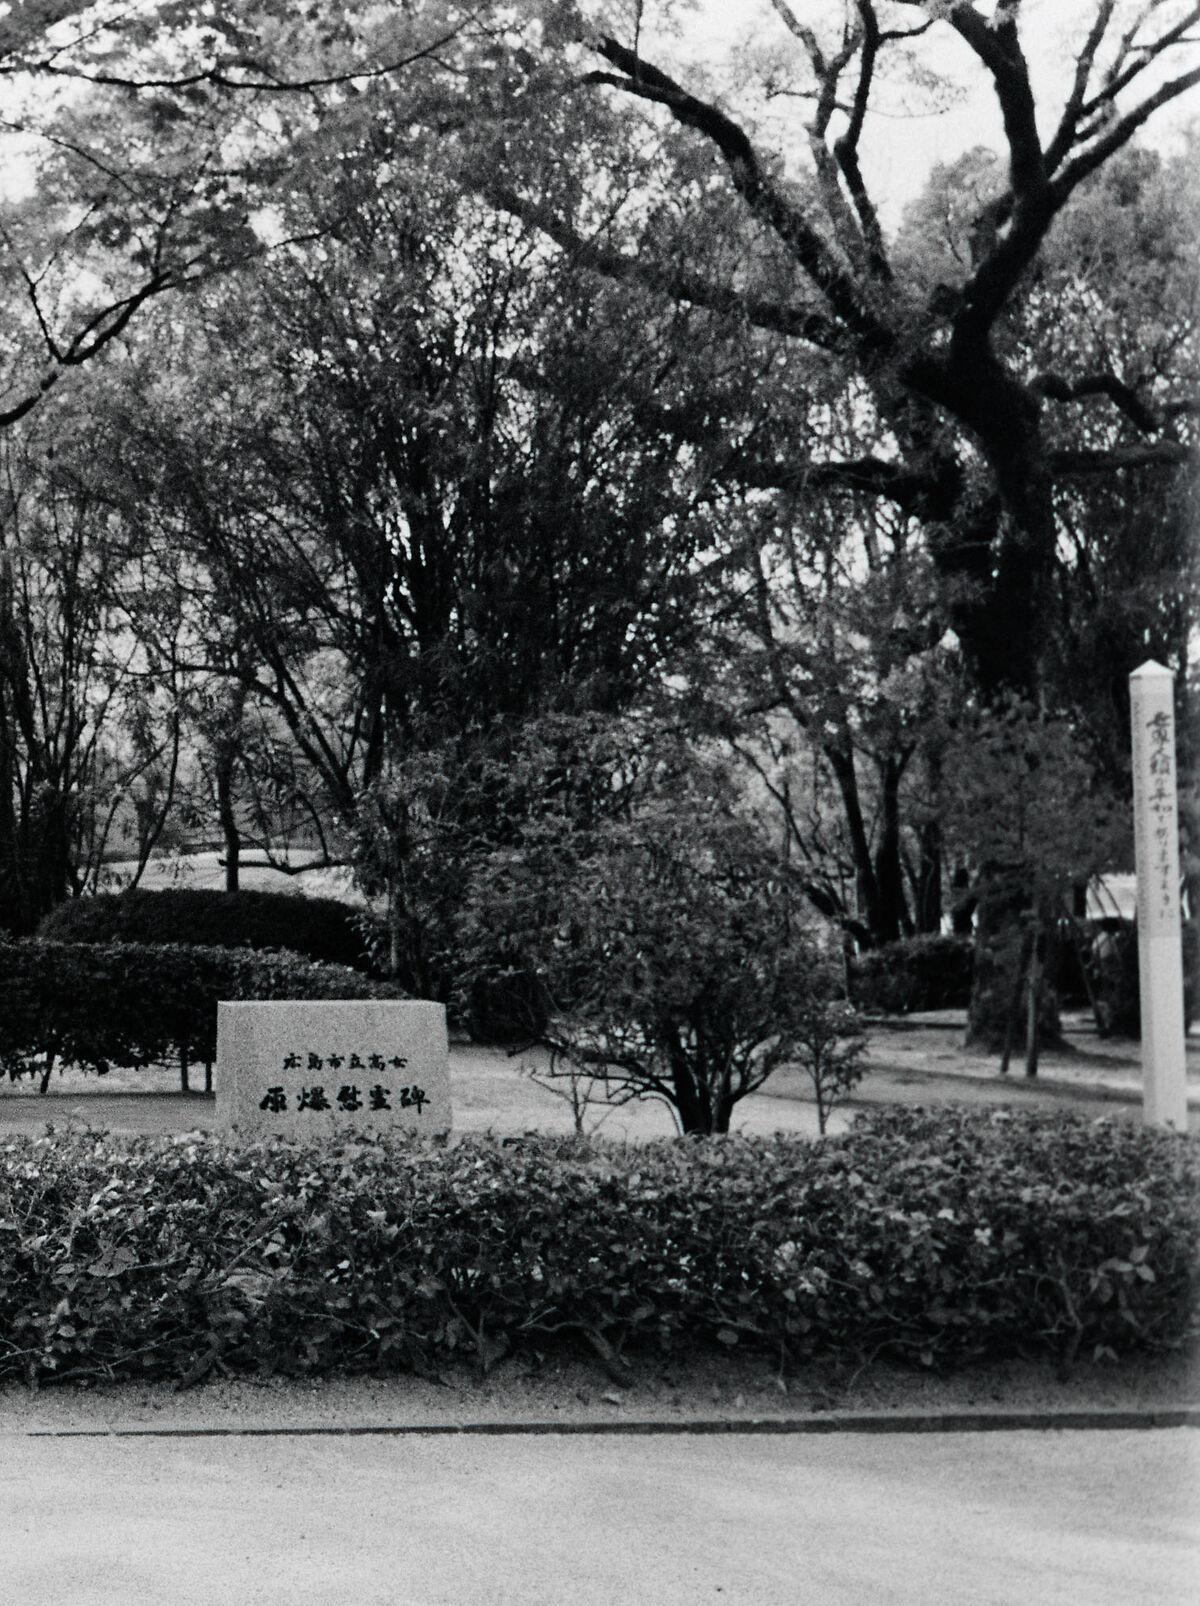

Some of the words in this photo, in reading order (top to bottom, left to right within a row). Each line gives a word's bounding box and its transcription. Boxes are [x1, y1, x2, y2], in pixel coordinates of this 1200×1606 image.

[283, 1052, 408, 1071] 広島市立高女
[259, 1085, 431, 1114] 原爆慰霊碑
